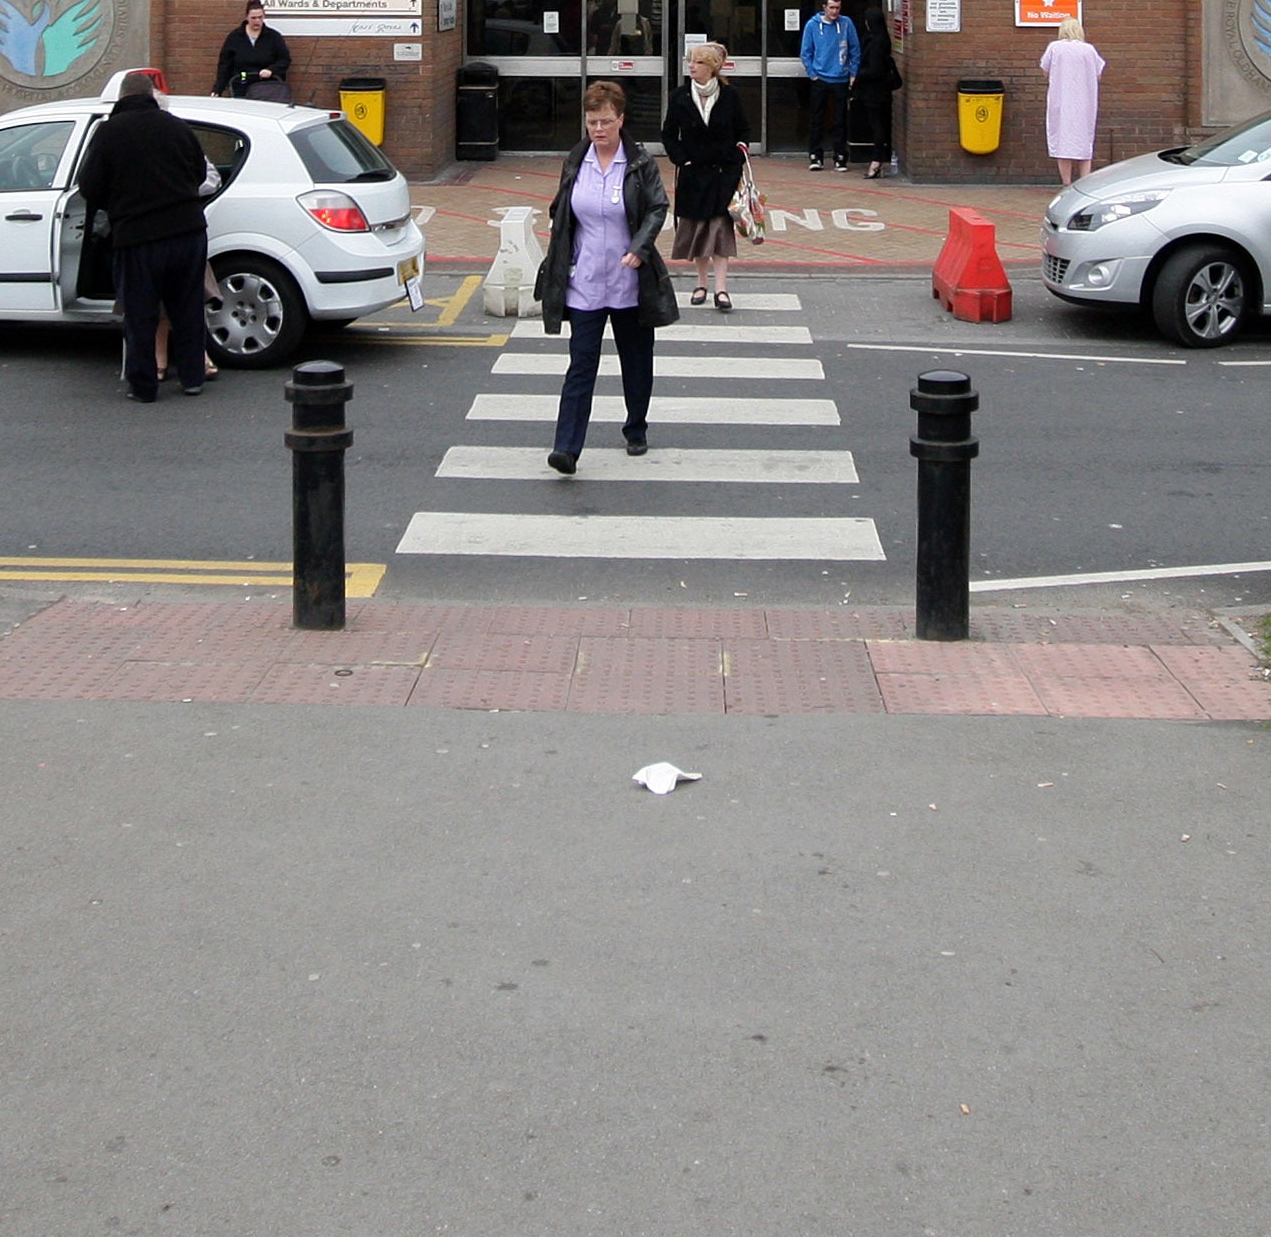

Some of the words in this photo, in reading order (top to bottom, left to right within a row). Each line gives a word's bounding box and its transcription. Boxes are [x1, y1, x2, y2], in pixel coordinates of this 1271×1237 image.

[262, 0, 275, 8] All
[280, 0, 309, 8] Wards
[312, 0, 320, 8] &
[322, 0, 388, 10] Departments
